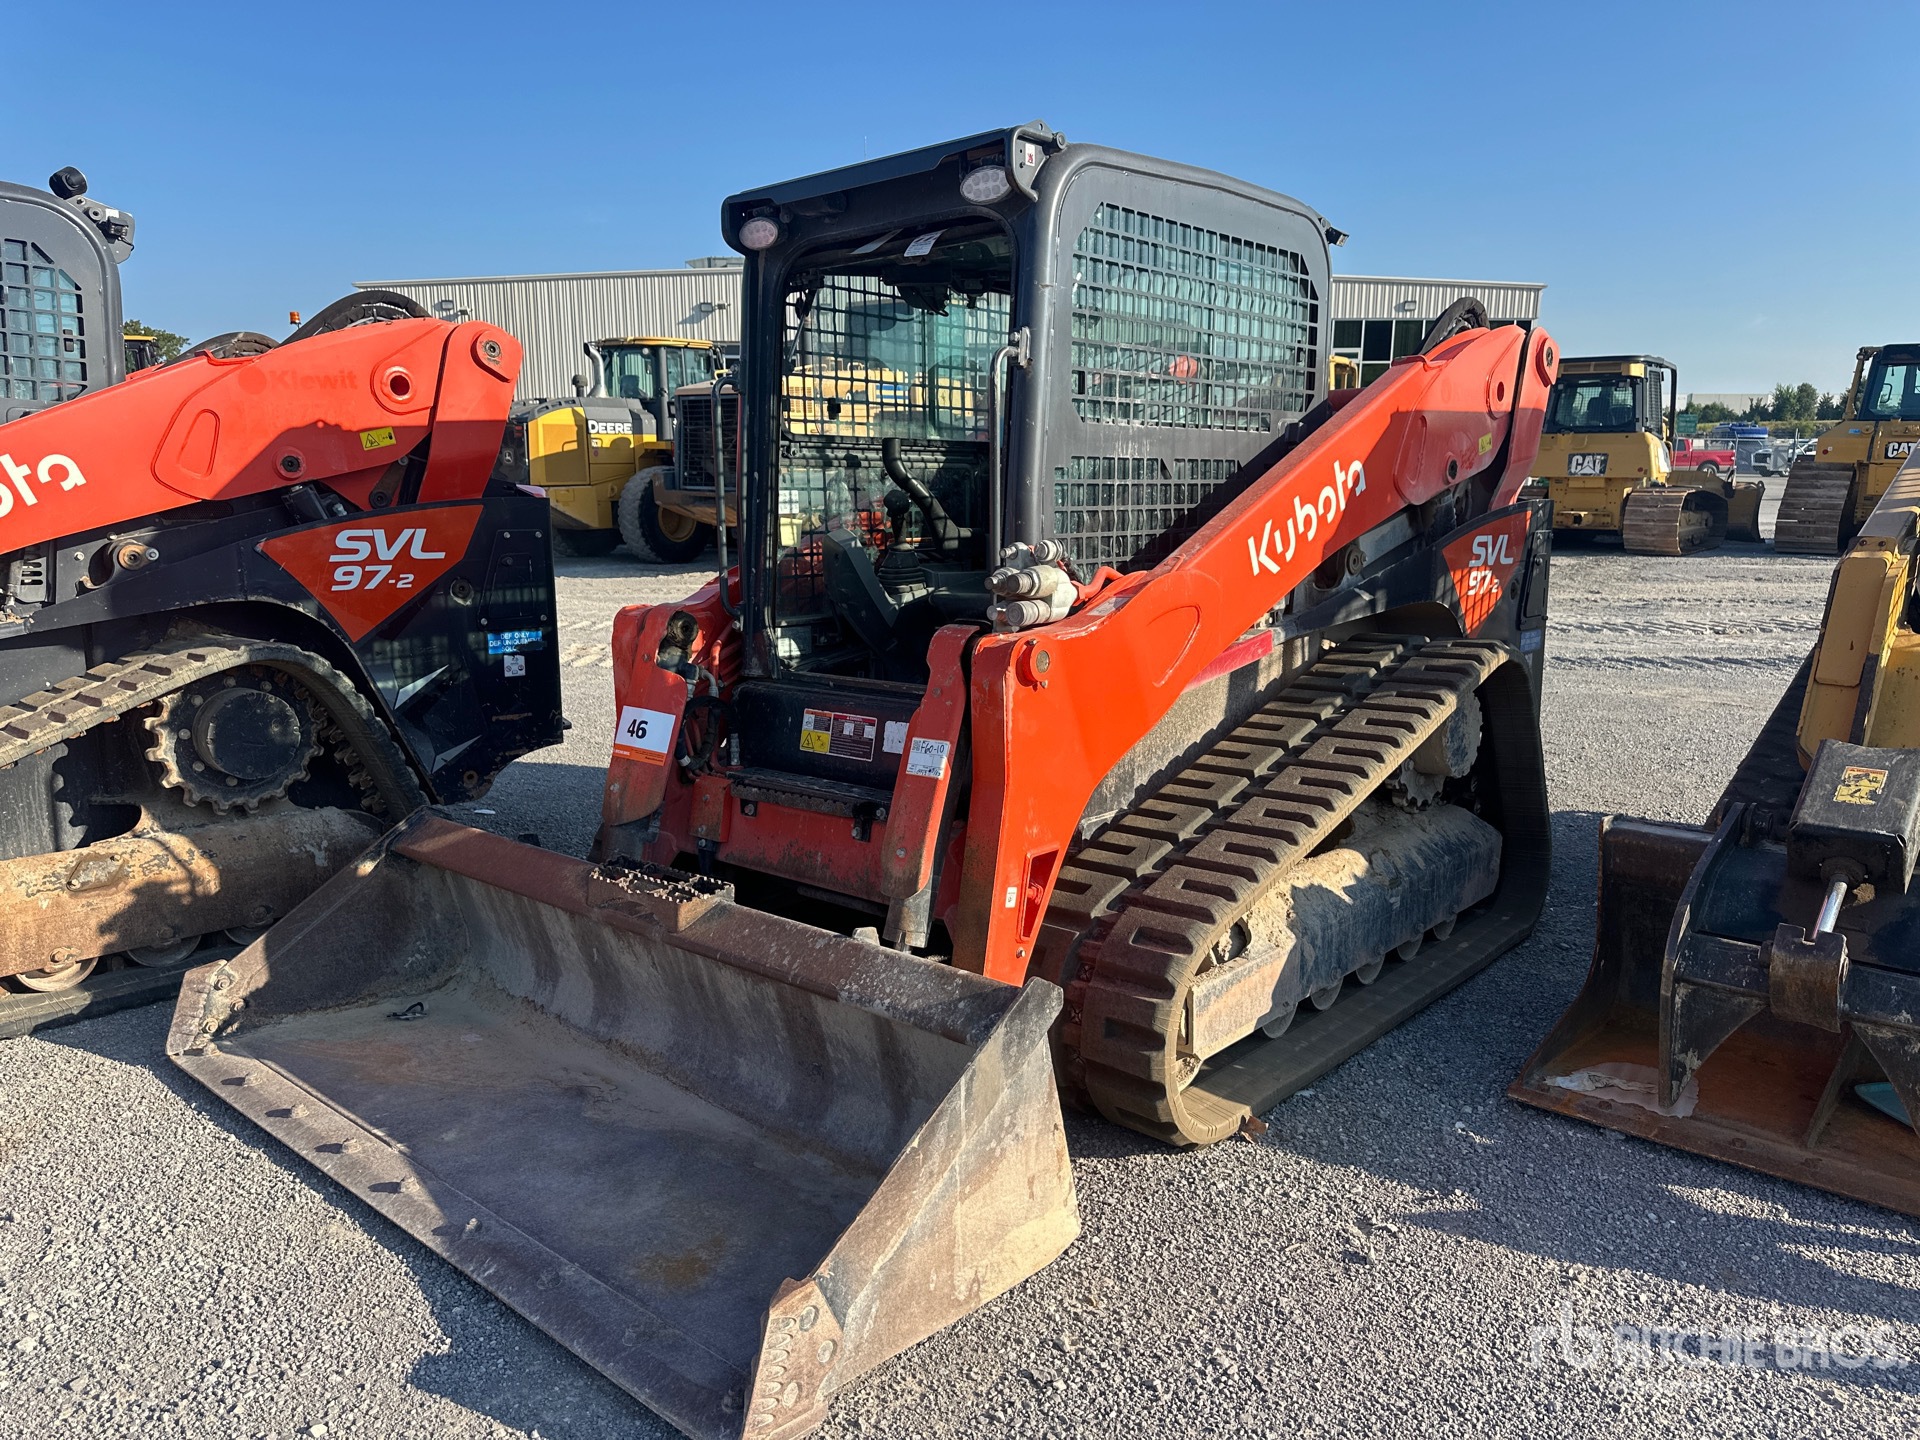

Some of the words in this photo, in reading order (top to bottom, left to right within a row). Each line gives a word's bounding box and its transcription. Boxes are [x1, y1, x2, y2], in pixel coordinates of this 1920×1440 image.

[587, 419, 633, 434] DEERE
[1887, 442, 1918, 459] CAT
[1570, 454, 1605, 475] CAT
[0, 453, 87, 519] ta
[1247, 459, 1367, 577] Kubota
[328, 528, 447, 562] SVL
[1468, 534, 1514, 568] SVL
[330, 564, 415, 592] 97-2
[1467, 570, 1500, 596] 97-2
[514, 631, 530, 639] ONLY
[627, 718, 649, 740] 46
